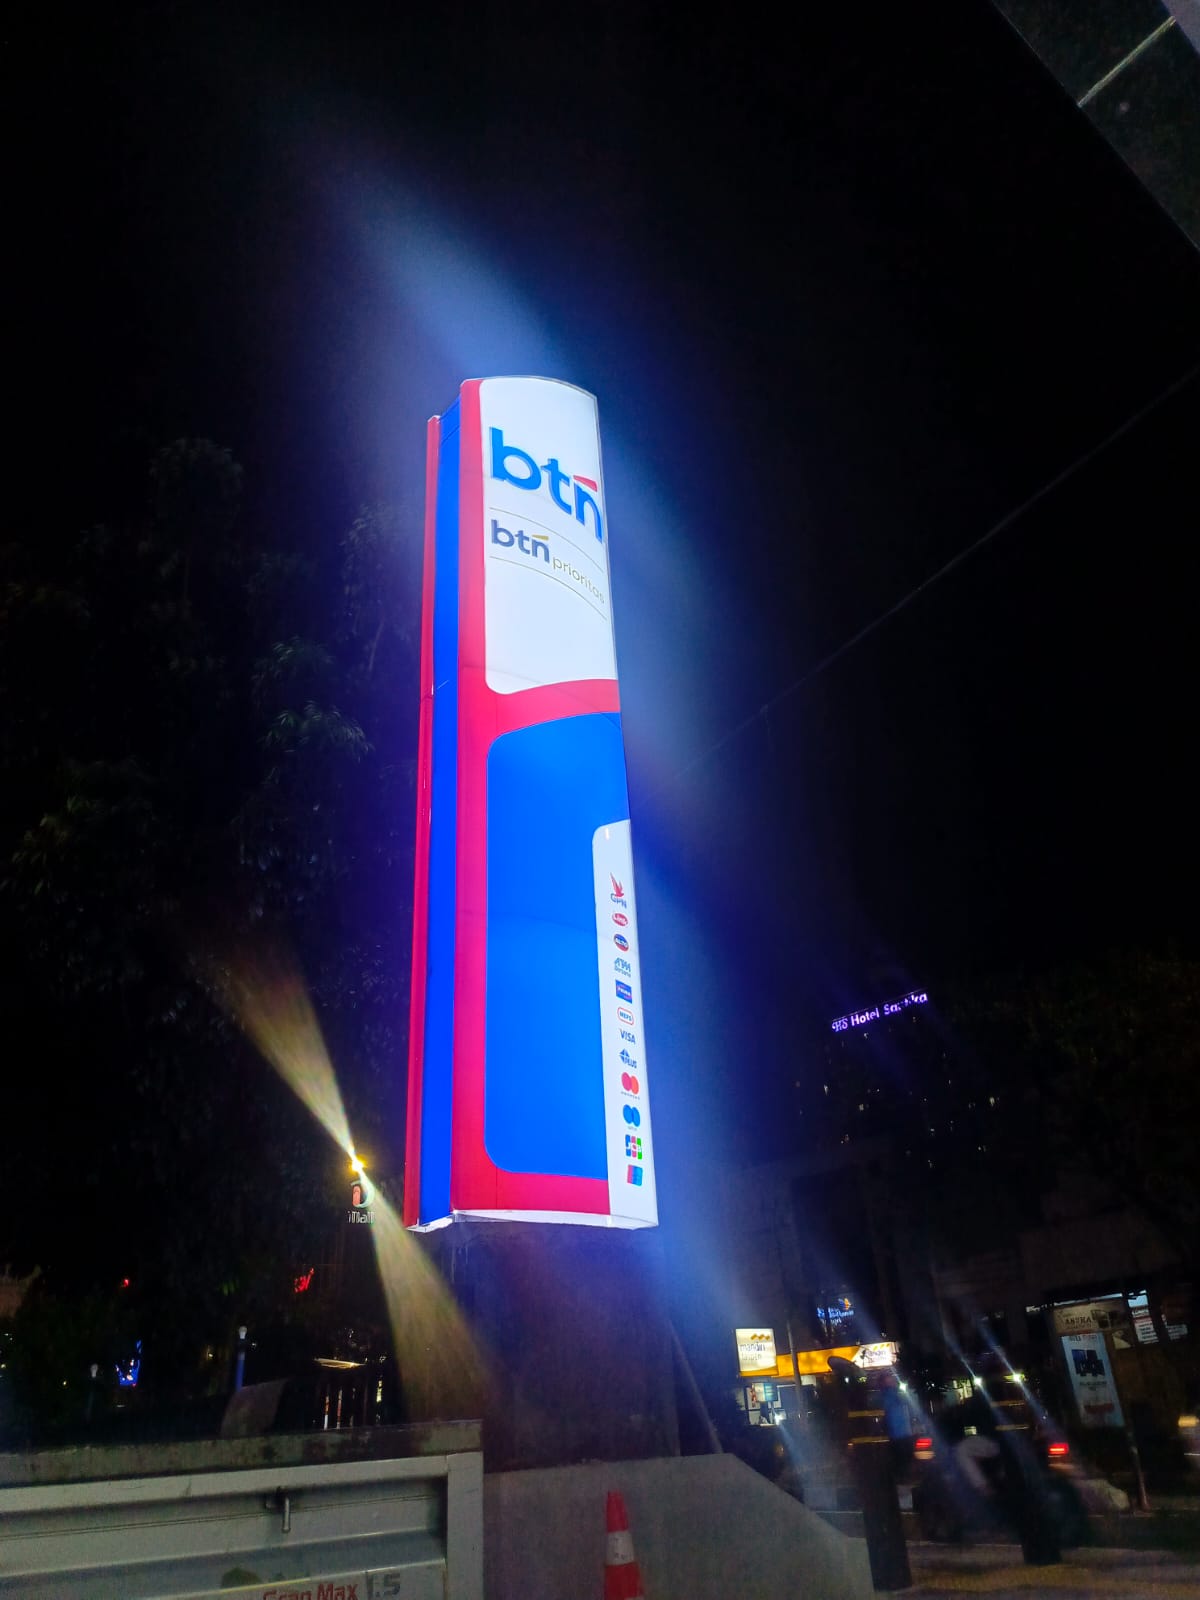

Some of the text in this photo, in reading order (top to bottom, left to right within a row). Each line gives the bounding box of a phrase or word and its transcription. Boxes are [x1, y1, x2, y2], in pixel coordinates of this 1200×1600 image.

[489, 427, 602, 544] btn
[491, 519, 604, 603] btn prioritas
[850, 1007, 880, 1026] Hotel
[883, 993, 928, 1015] Satka
[619, 1029, 636, 1044] VISA
[316, 1583, 359, 1600] Max
